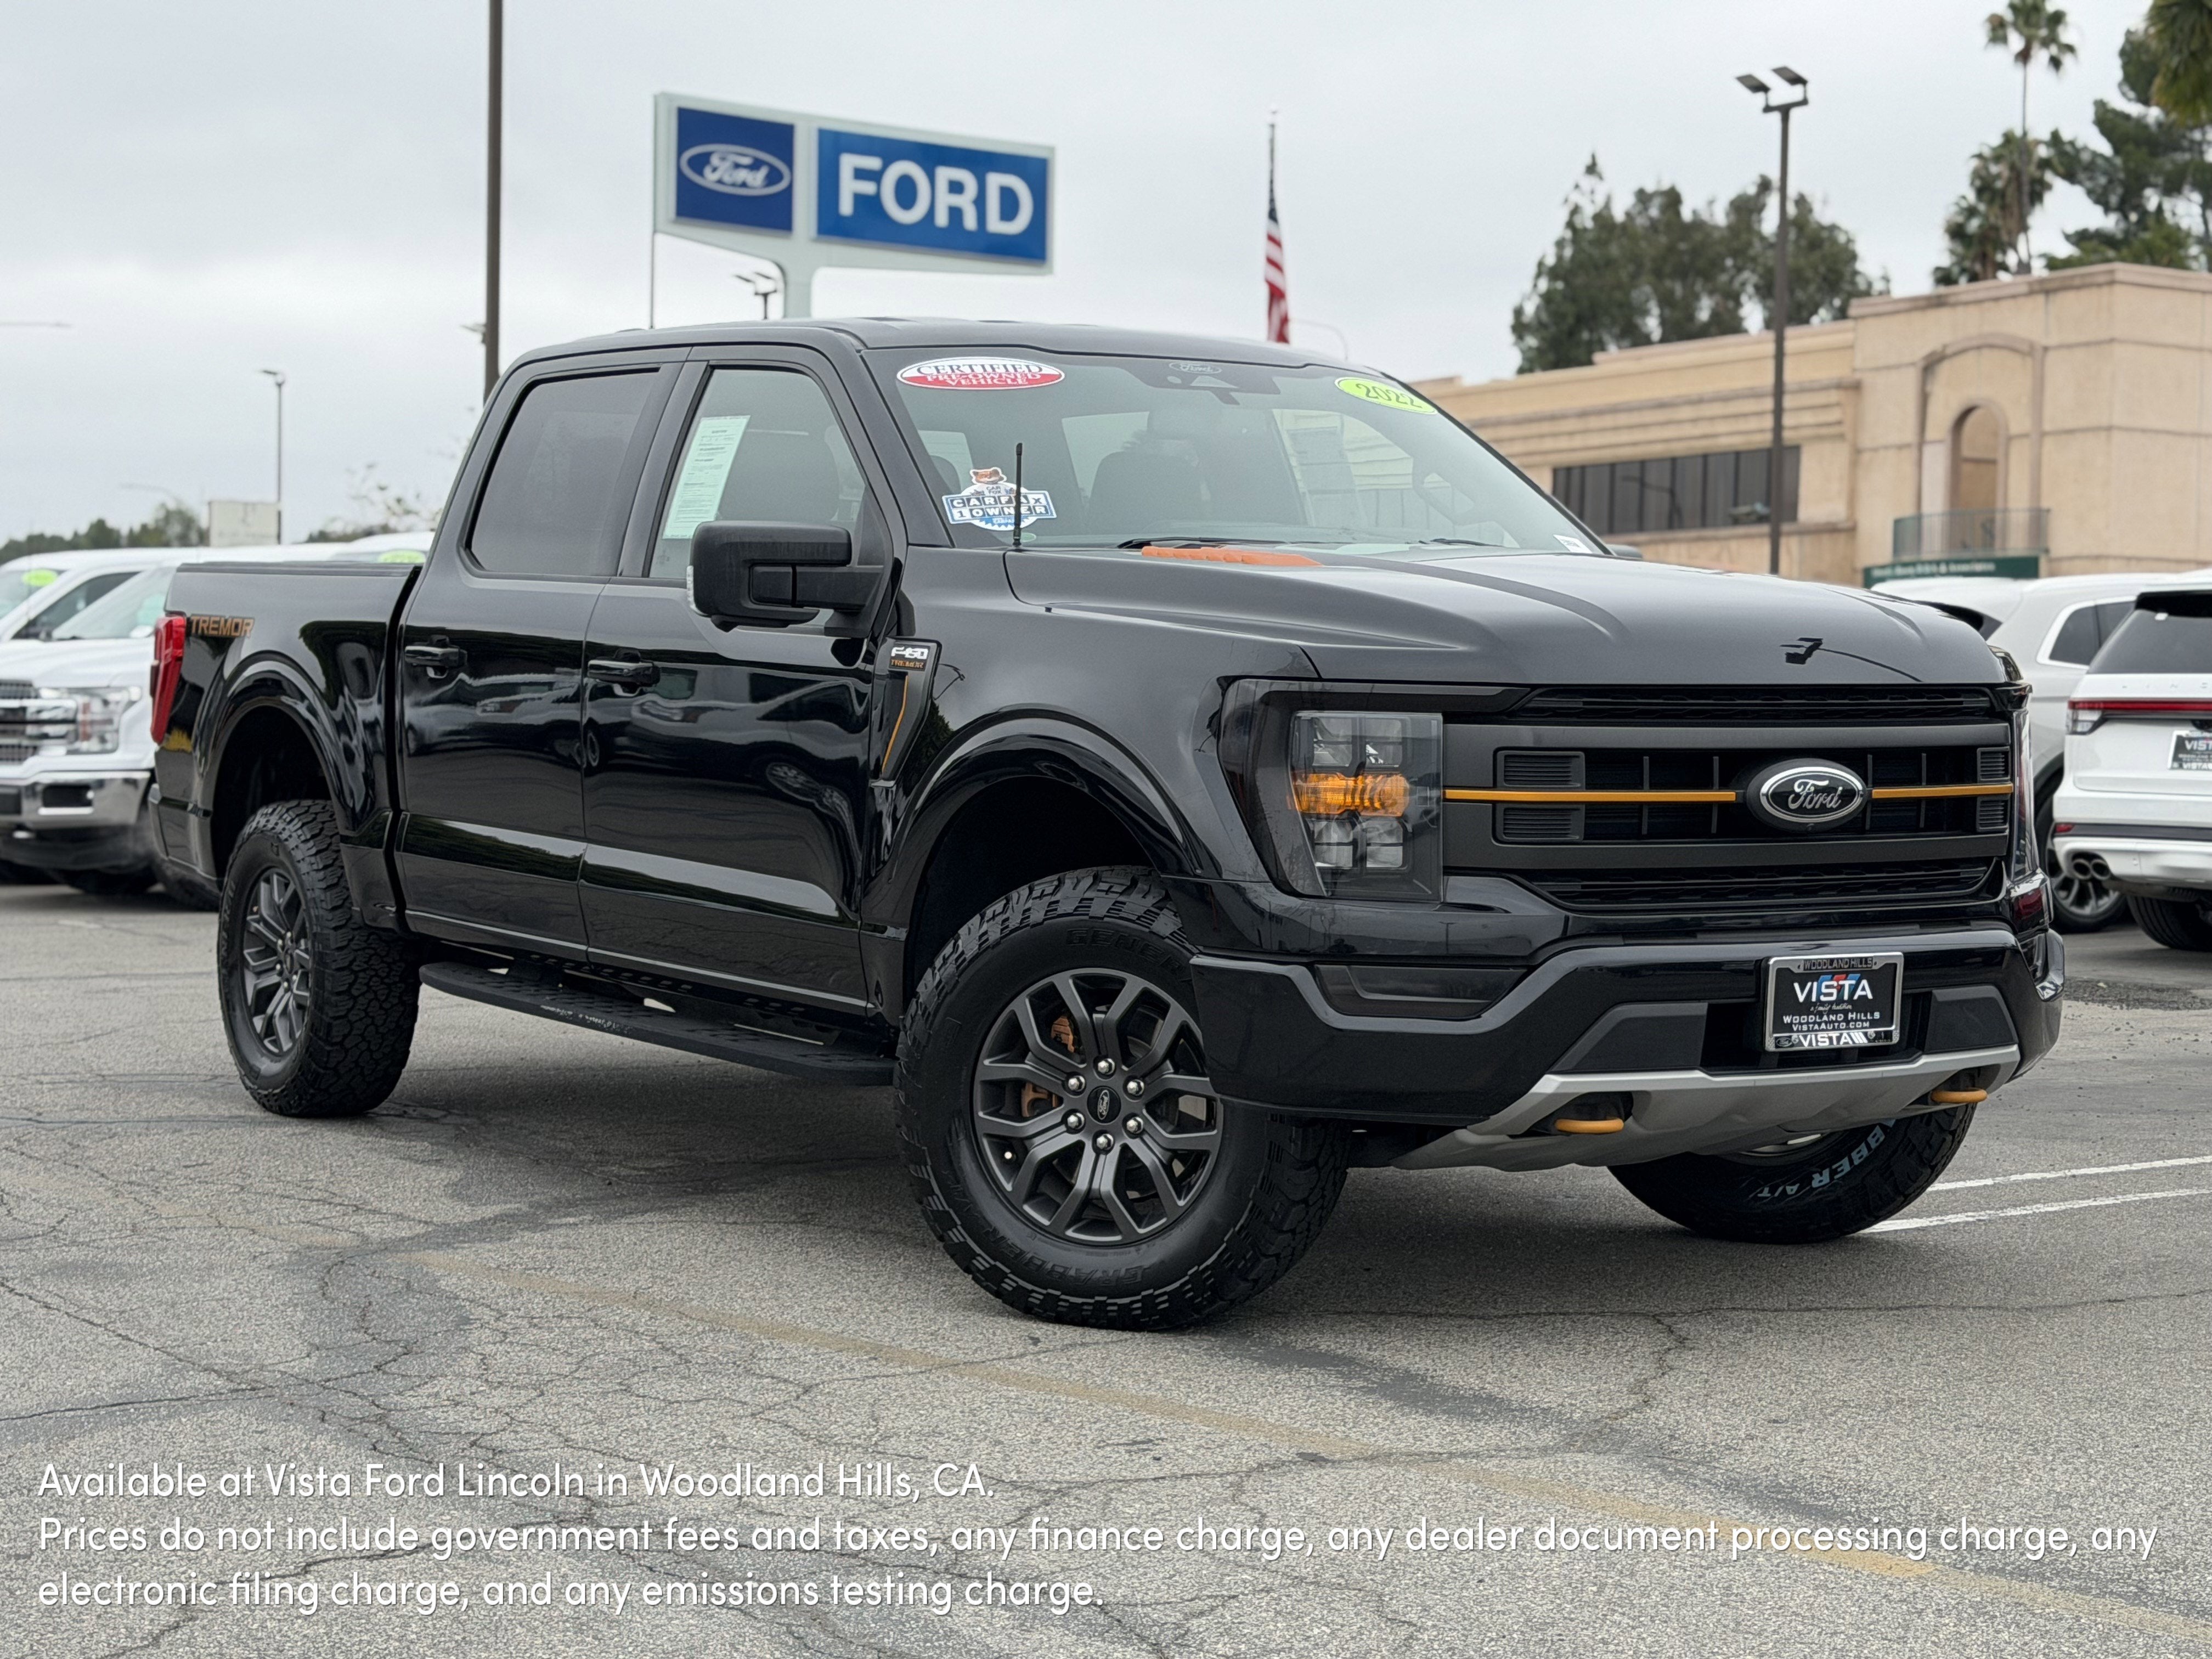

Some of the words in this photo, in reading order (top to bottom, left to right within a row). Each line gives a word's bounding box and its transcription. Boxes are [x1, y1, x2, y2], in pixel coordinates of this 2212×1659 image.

[703, 152, 769, 188] Ford
[838, 153, 1034, 235] FORD
[916, 364, 1043, 375] CERTIFIED
[926, 373, 1041, 381] PRE-OWNED
[946, 377, 1029, 386] VEHICLE
[1355, 383, 1423, 409] 2022
[952, 494, 1043, 507] CARFAX
[956, 509, 967, 518] 1
[972, 505, 1046, 518] OWNER
[190, 614, 255, 639] TREMOR
[1788, 779, 1843, 810] Ford
[1804, 959, 1849, 970] WOODLAND
[1850, 958, 1873, 968] HILLS
[1793, 979, 1873, 1003] VISTA
[1783, 1014, 1844, 1024] WOODLAND
[1848, 1012, 1880, 1020] HILLS
[1798, 1032, 1853, 1047] VISTA
[1811, 1122, 1893, 1189] BBER
